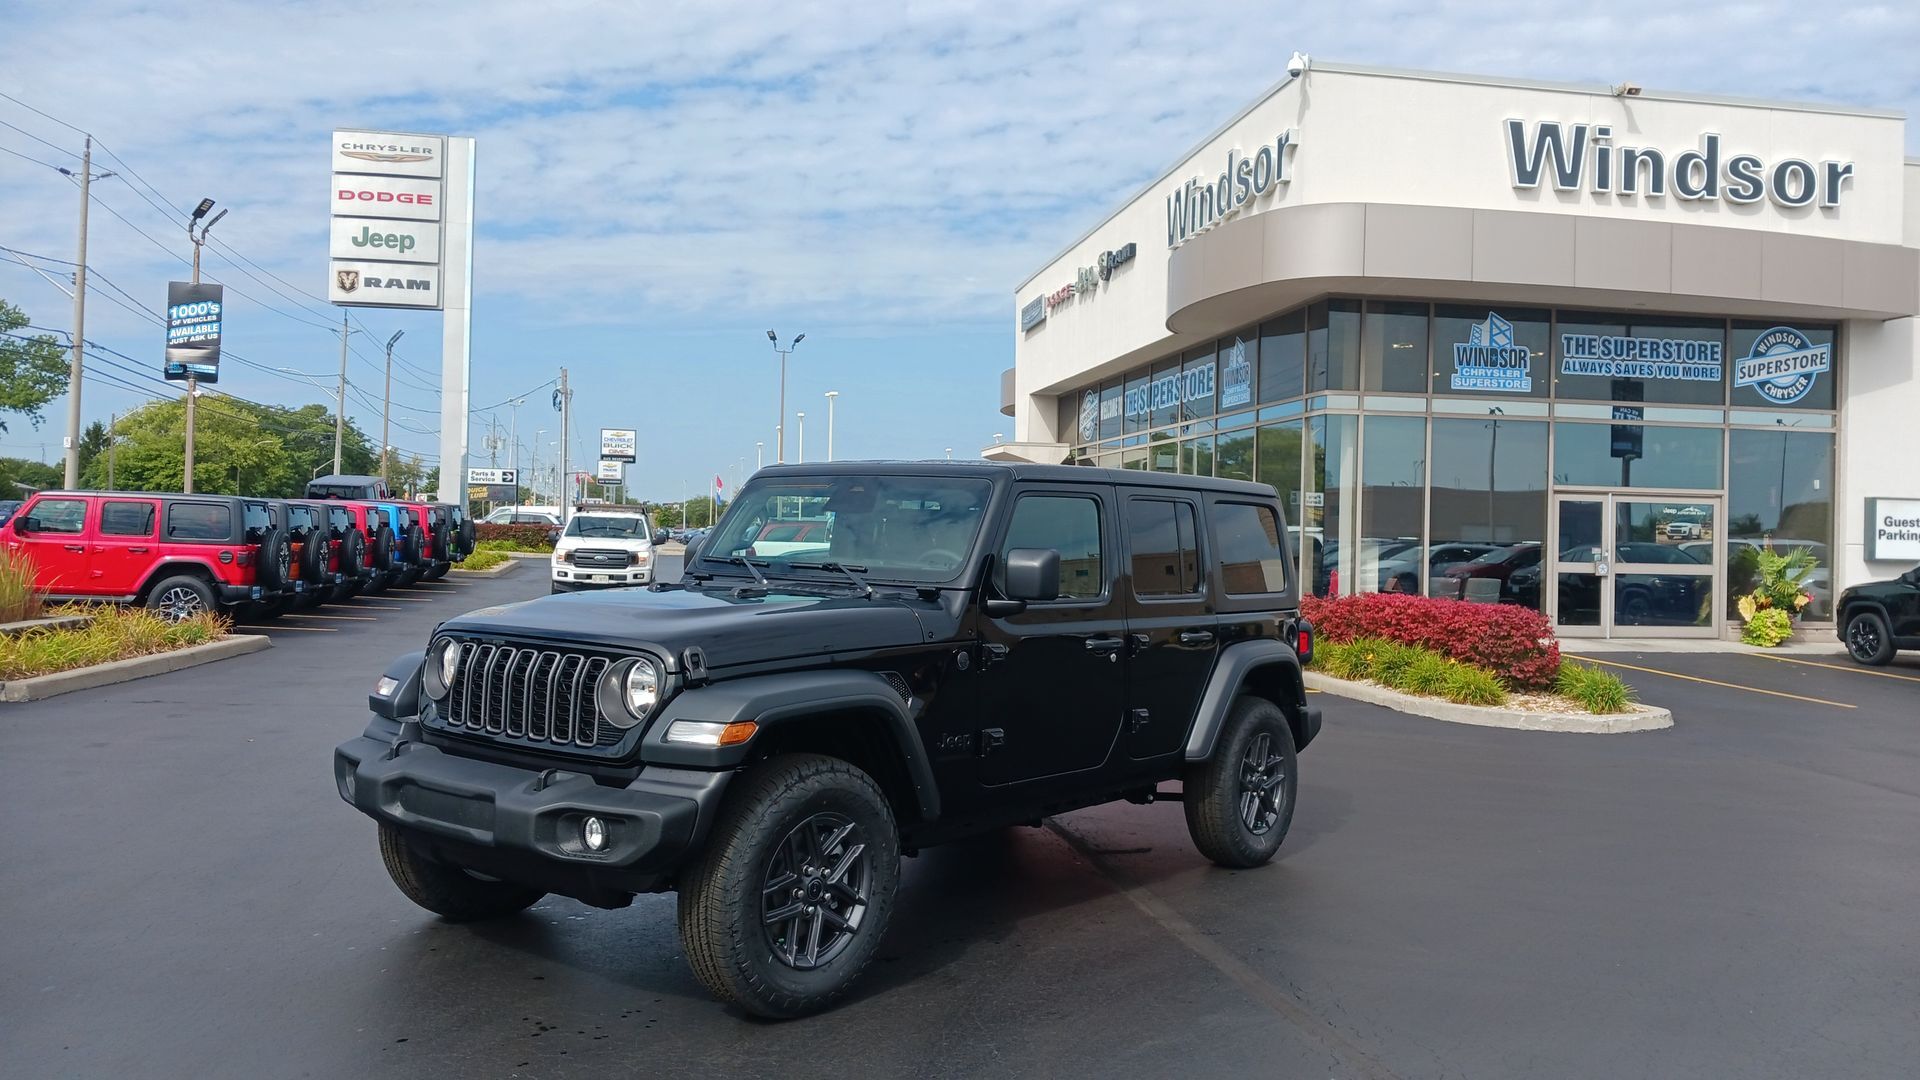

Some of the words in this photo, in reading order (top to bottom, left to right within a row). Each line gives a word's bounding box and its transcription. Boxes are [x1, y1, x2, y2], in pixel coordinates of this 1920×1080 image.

[341, 142, 433, 154] CHRYSLER
[1503, 118, 1854, 208] Windsor
[338, 190, 433, 205] DODGE
[1166, 128, 1298, 250] Windsor
[351, 226, 416, 254] Jeep
[363, 276, 431, 290] RAM
[182, 315, 217, 324] VEHICLES
[170, 323, 219, 337] AVAILABLE
[169, 336, 188, 345] JUST
[190, 334, 205, 342] ASK
[1757, 333, 1801, 353] WINDSOR
[1456, 346, 1528, 369] WINDSOR
[1563, 336, 1597, 356] THE
[1601, 337, 1720, 362] SUPERSTORE
[1462, 368, 1520, 378] CHRYSLER
[1563, 359, 1612, 374] ALWAYS
[1615, 362, 1654, 376] SAVES
[1657, 365, 1679, 377] YOU
[1682, 366, 1720, 379] MORE!
[1739, 352, 1826, 379] SUPERSTORE
[1126, 389, 1138, 416] THE
[1138, 363, 1215, 414] SUPERSTORE
[1454, 377, 1529, 388] SUPERSTORE
[1764, 376, 1808, 399] CHRYSLER
[1884, 515, 1920, 528] Guest
[1878, 529, 1920, 543] Parkin
[936, 733, 970, 751] Jeep
